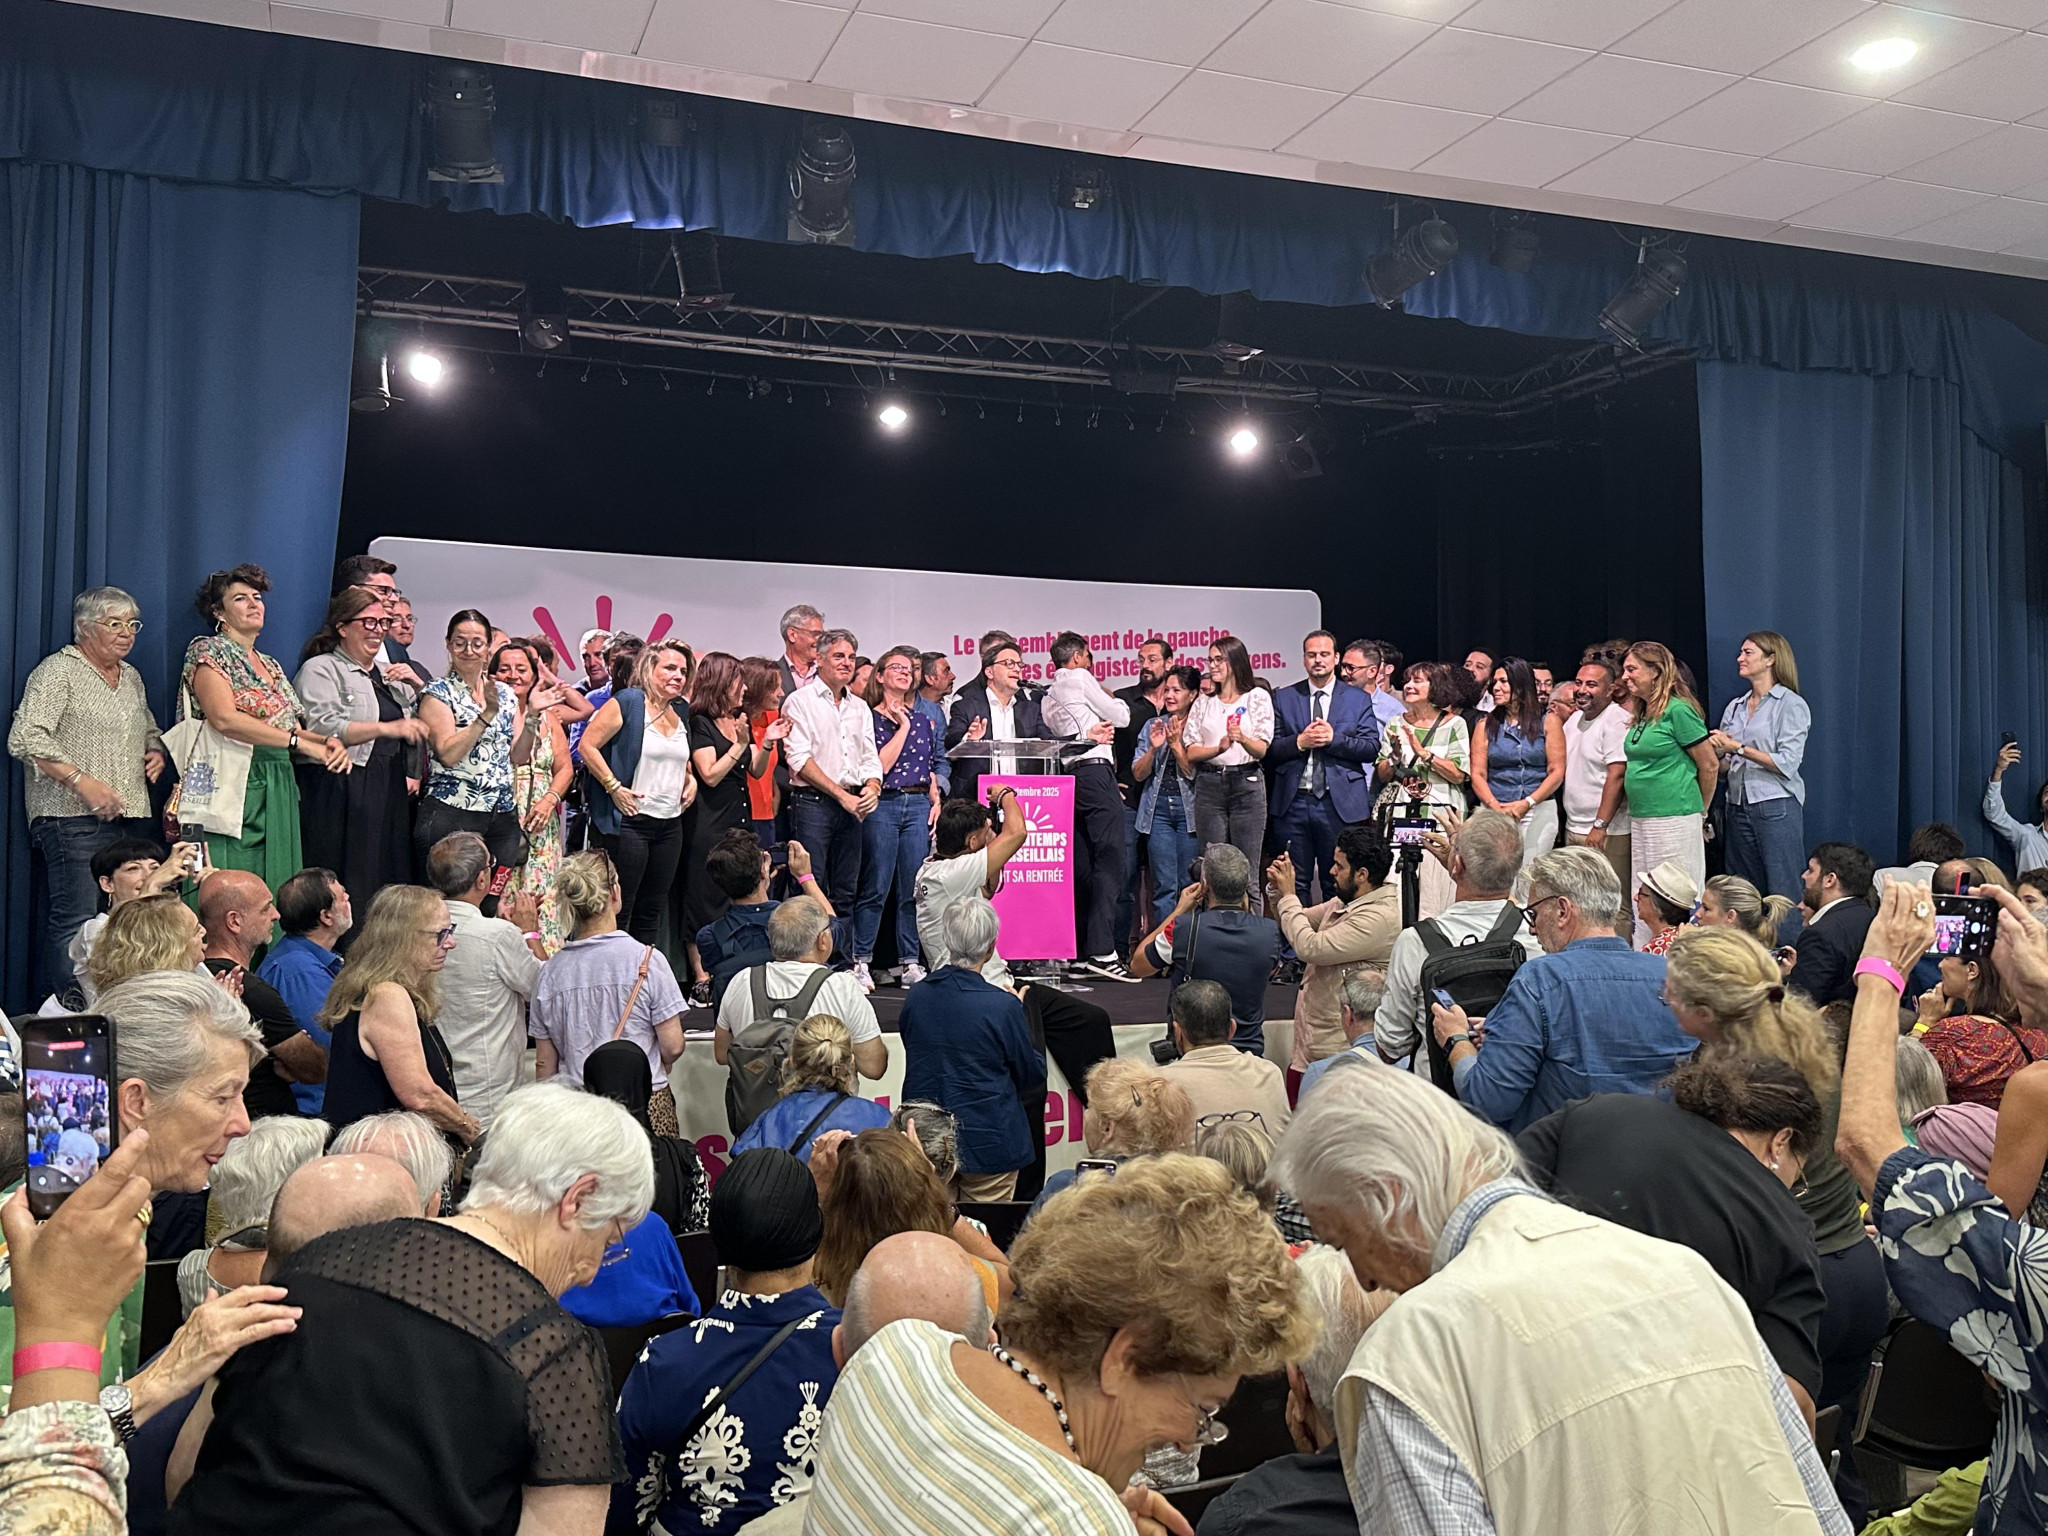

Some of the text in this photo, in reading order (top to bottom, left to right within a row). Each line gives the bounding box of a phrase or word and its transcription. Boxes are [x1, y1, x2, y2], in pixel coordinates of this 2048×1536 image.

[954, 635, 975, 655] Le
[1123, 629, 1144, 650] de
[1022, 663, 1042, 680] es
[1015, 786, 1059, 797] tembre 2025
[1022, 832, 1067, 847] NTEMPS
[1008, 847, 1065, 863] SEILLAIS
[1012, 869, 1024, 883] SA
[1026, 867, 1063, 883] RENTRÉE
